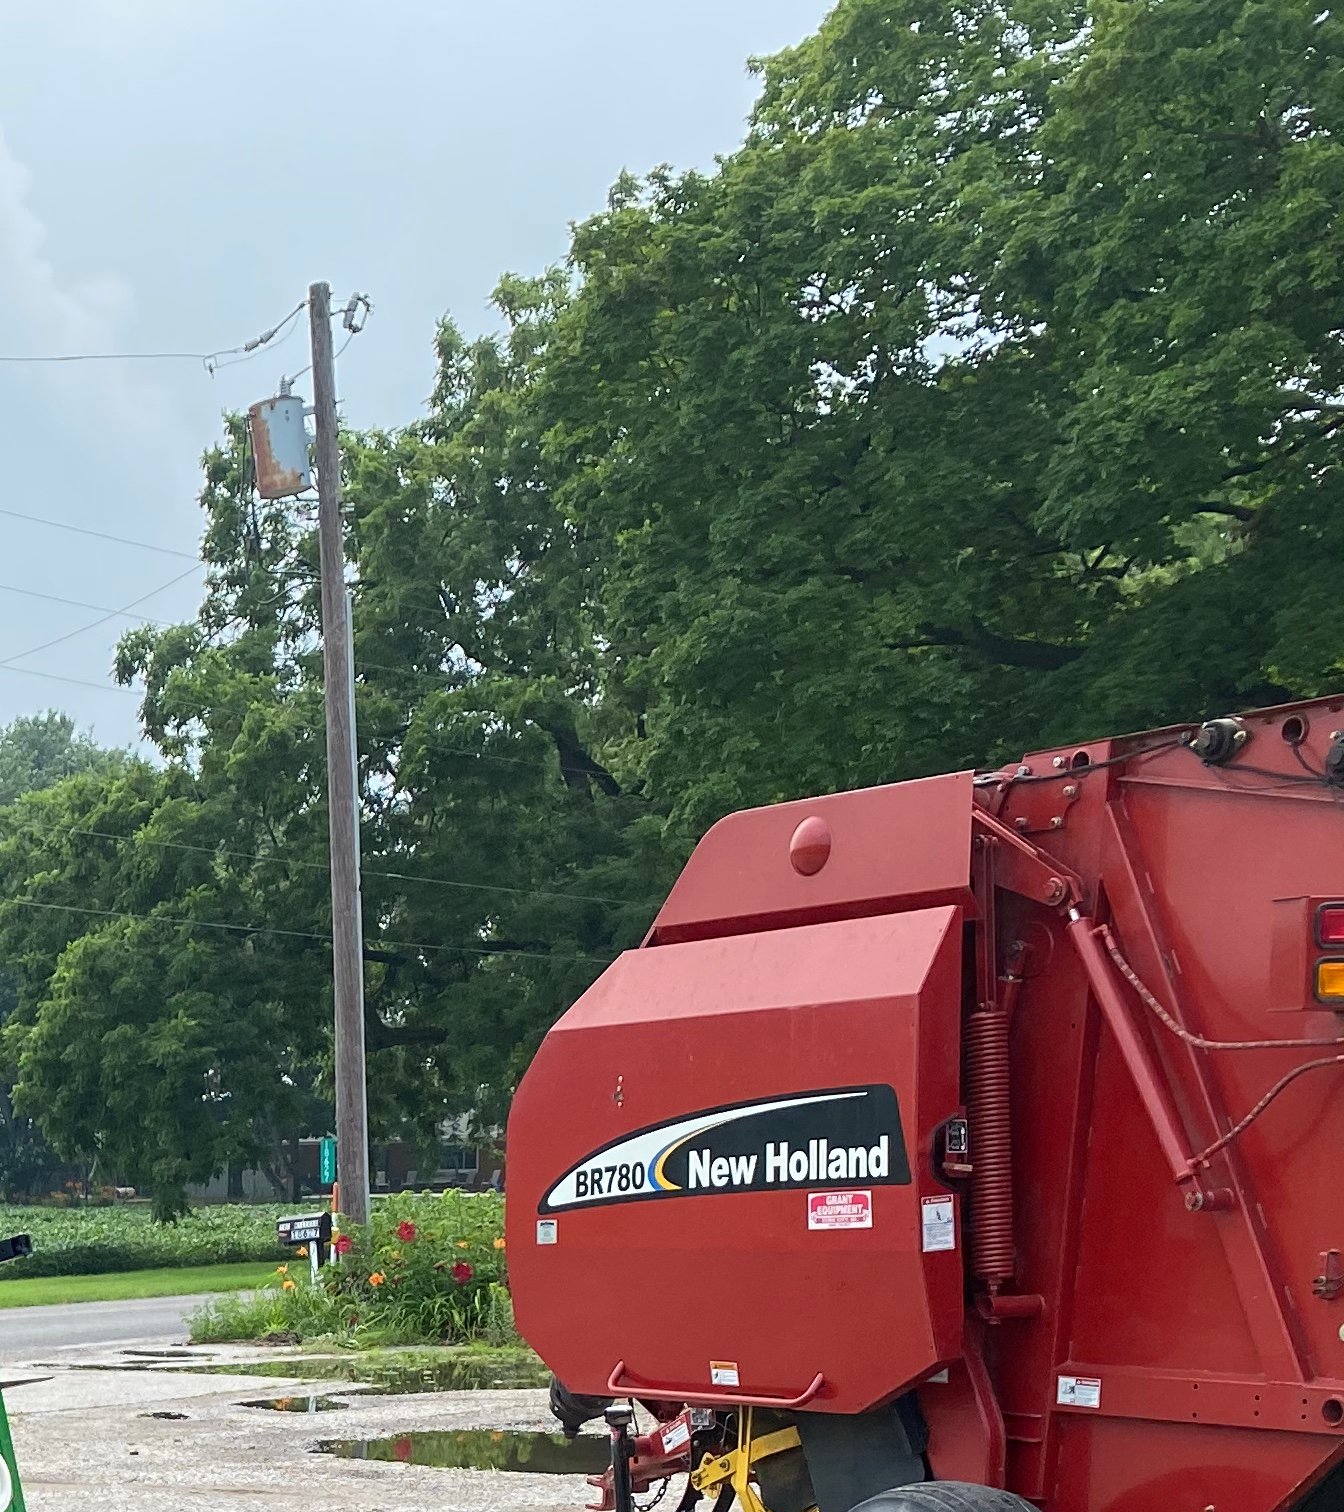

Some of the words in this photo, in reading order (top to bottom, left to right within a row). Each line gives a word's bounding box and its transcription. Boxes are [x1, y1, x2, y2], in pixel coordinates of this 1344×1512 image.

[688, 1148, 758, 1189] New
[765, 1134, 889, 1184] Holland
[575, 1161, 646, 1199] BR780
[816, 1204, 864, 1216] EQUIPMENT
[825, 1194, 854, 1206] GRANT
